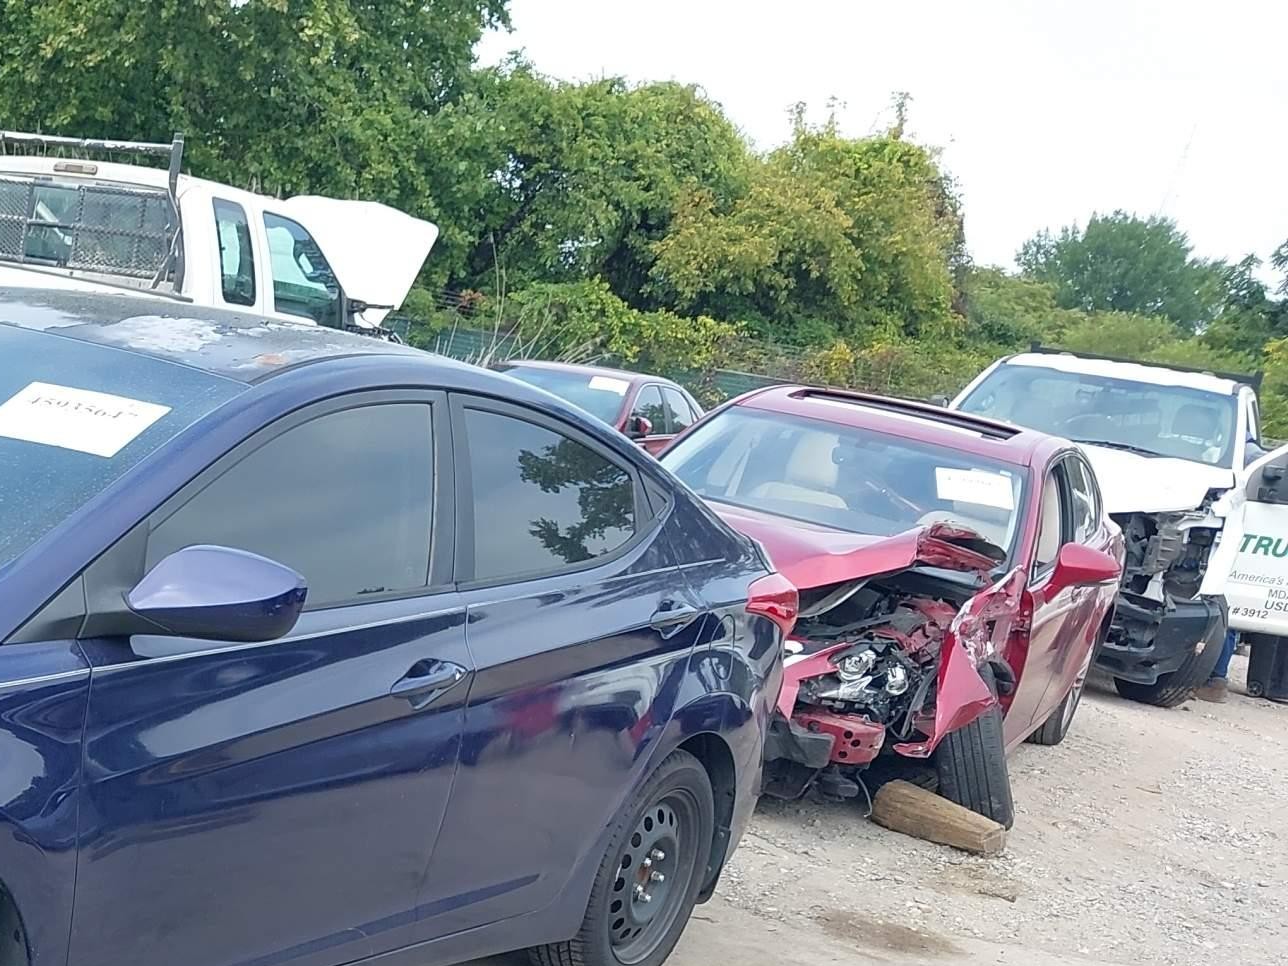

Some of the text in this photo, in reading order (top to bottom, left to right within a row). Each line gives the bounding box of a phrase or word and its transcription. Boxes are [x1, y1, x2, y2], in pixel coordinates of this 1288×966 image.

[1239, 533, 1288, 558] TRU
[1228, 569, 1284, 586] America's
[1267, 588, 1288, 600] MD
[1241, 607, 1269, 619] 3912
